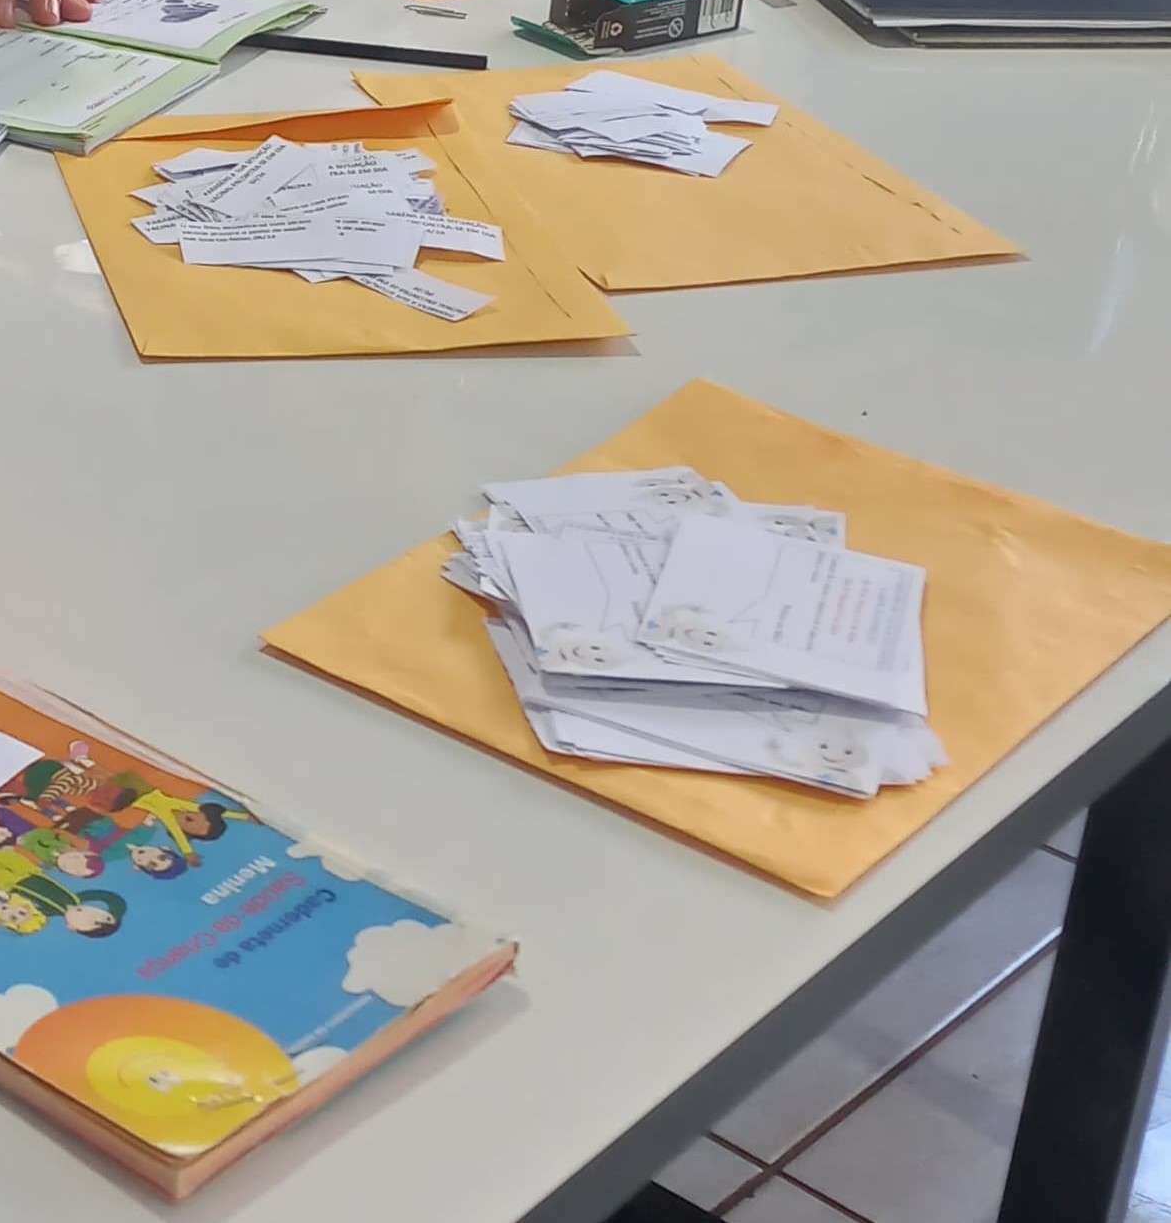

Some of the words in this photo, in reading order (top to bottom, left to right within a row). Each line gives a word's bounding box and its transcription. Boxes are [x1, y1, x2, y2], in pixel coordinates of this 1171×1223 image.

[200, 854, 277, 907] Menina
[239, 871, 307, 918] Saúde
[238, 887, 338, 953] Caderneta
[137, 931, 219, 980] Criança
[212, 950, 242, 970] de
